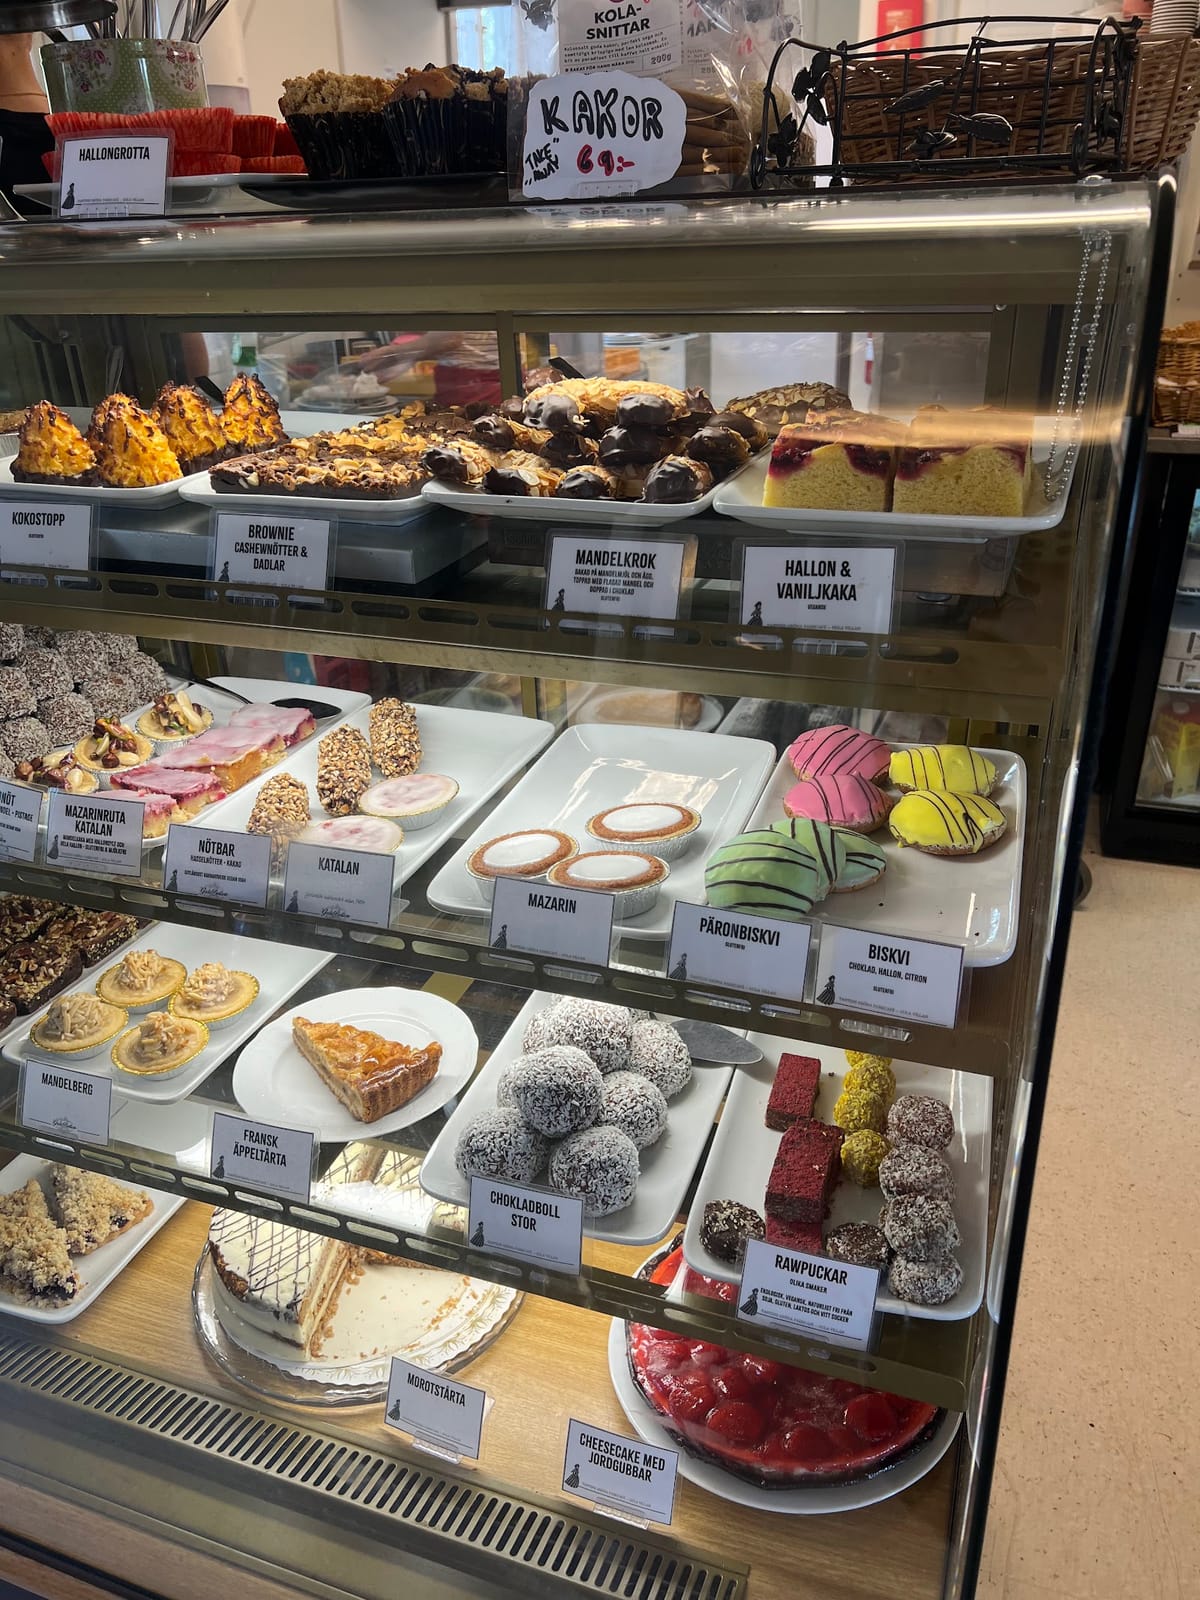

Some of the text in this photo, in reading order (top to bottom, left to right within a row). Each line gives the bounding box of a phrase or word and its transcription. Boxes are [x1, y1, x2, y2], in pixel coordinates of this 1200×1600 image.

[594, 4, 642, 24] KOLA-
[586, 18, 650, 40] SNITTAR
[650, 53, 672, 65] 200g
[541, 88, 663, 141] KAKOR
[79, 146, 150, 161] HALLONGROTTA
[577, 144, 635, 176] 69:-
[12, 511, 65, 526] KOKOSTOPP
[248, 524, 295, 541] BROWNIE
[234, 541, 308, 558] CASHEWNÖTTER &
[575, 549, 657, 570] MANDELKROK
[253, 558, 285, 572] DADLAR
[631, 571, 641, 579] OCH
[785, 559, 852, 578] HALLON &
[574, 576, 591, 584] TOPPAD
[591, 577, 602, 585] MED
[622, 580, 642, 588] MANDEL
[612, 587, 635, 595] CHOKLAD
[777, 582, 857, 602] VANILJKAKA
[65, 804, 126, 824] MAZARINRUTA
[75, 820, 113, 837] KATALAN
[198, 838, 235, 857] NÖTBAR
[318, 857, 359, 875] KATALAN
[528, 892, 577, 914] MAZARIN
[699, 915, 781, 946] PÄRONBISKVI
[868, 944, 911, 966] BISKVI
[848, 961, 928, 984] CHOKLAD, HALLON, CITRON
[41, 1072, 94, 1096] MANDELBERG
[243, 1129, 279, 1149] FRANSK
[490, 1190, 561, 1219] CHOKLADBOLL
[511, 1213, 537, 1232] STOR
[774, 1254, 848, 1286] RAWPUCKAR
[789, 1278, 828, 1294] OLIKA SMAKER
[785, 1294, 807, 1306] VEGANSK,
[840, 1307, 853, 1317] FRÅN
[793, 1303, 810, 1314] LAKTOS
[810, 1308, 820, 1317] OCH
[831, 1313, 849, 1323] SOCKER
[407, 1372, 465, 1407] MOROTSTÅRTA
[579, 1432, 665, 1471] CHEESECAKE MED
[588, 1452, 652, 1483] JORDGUBBAR
